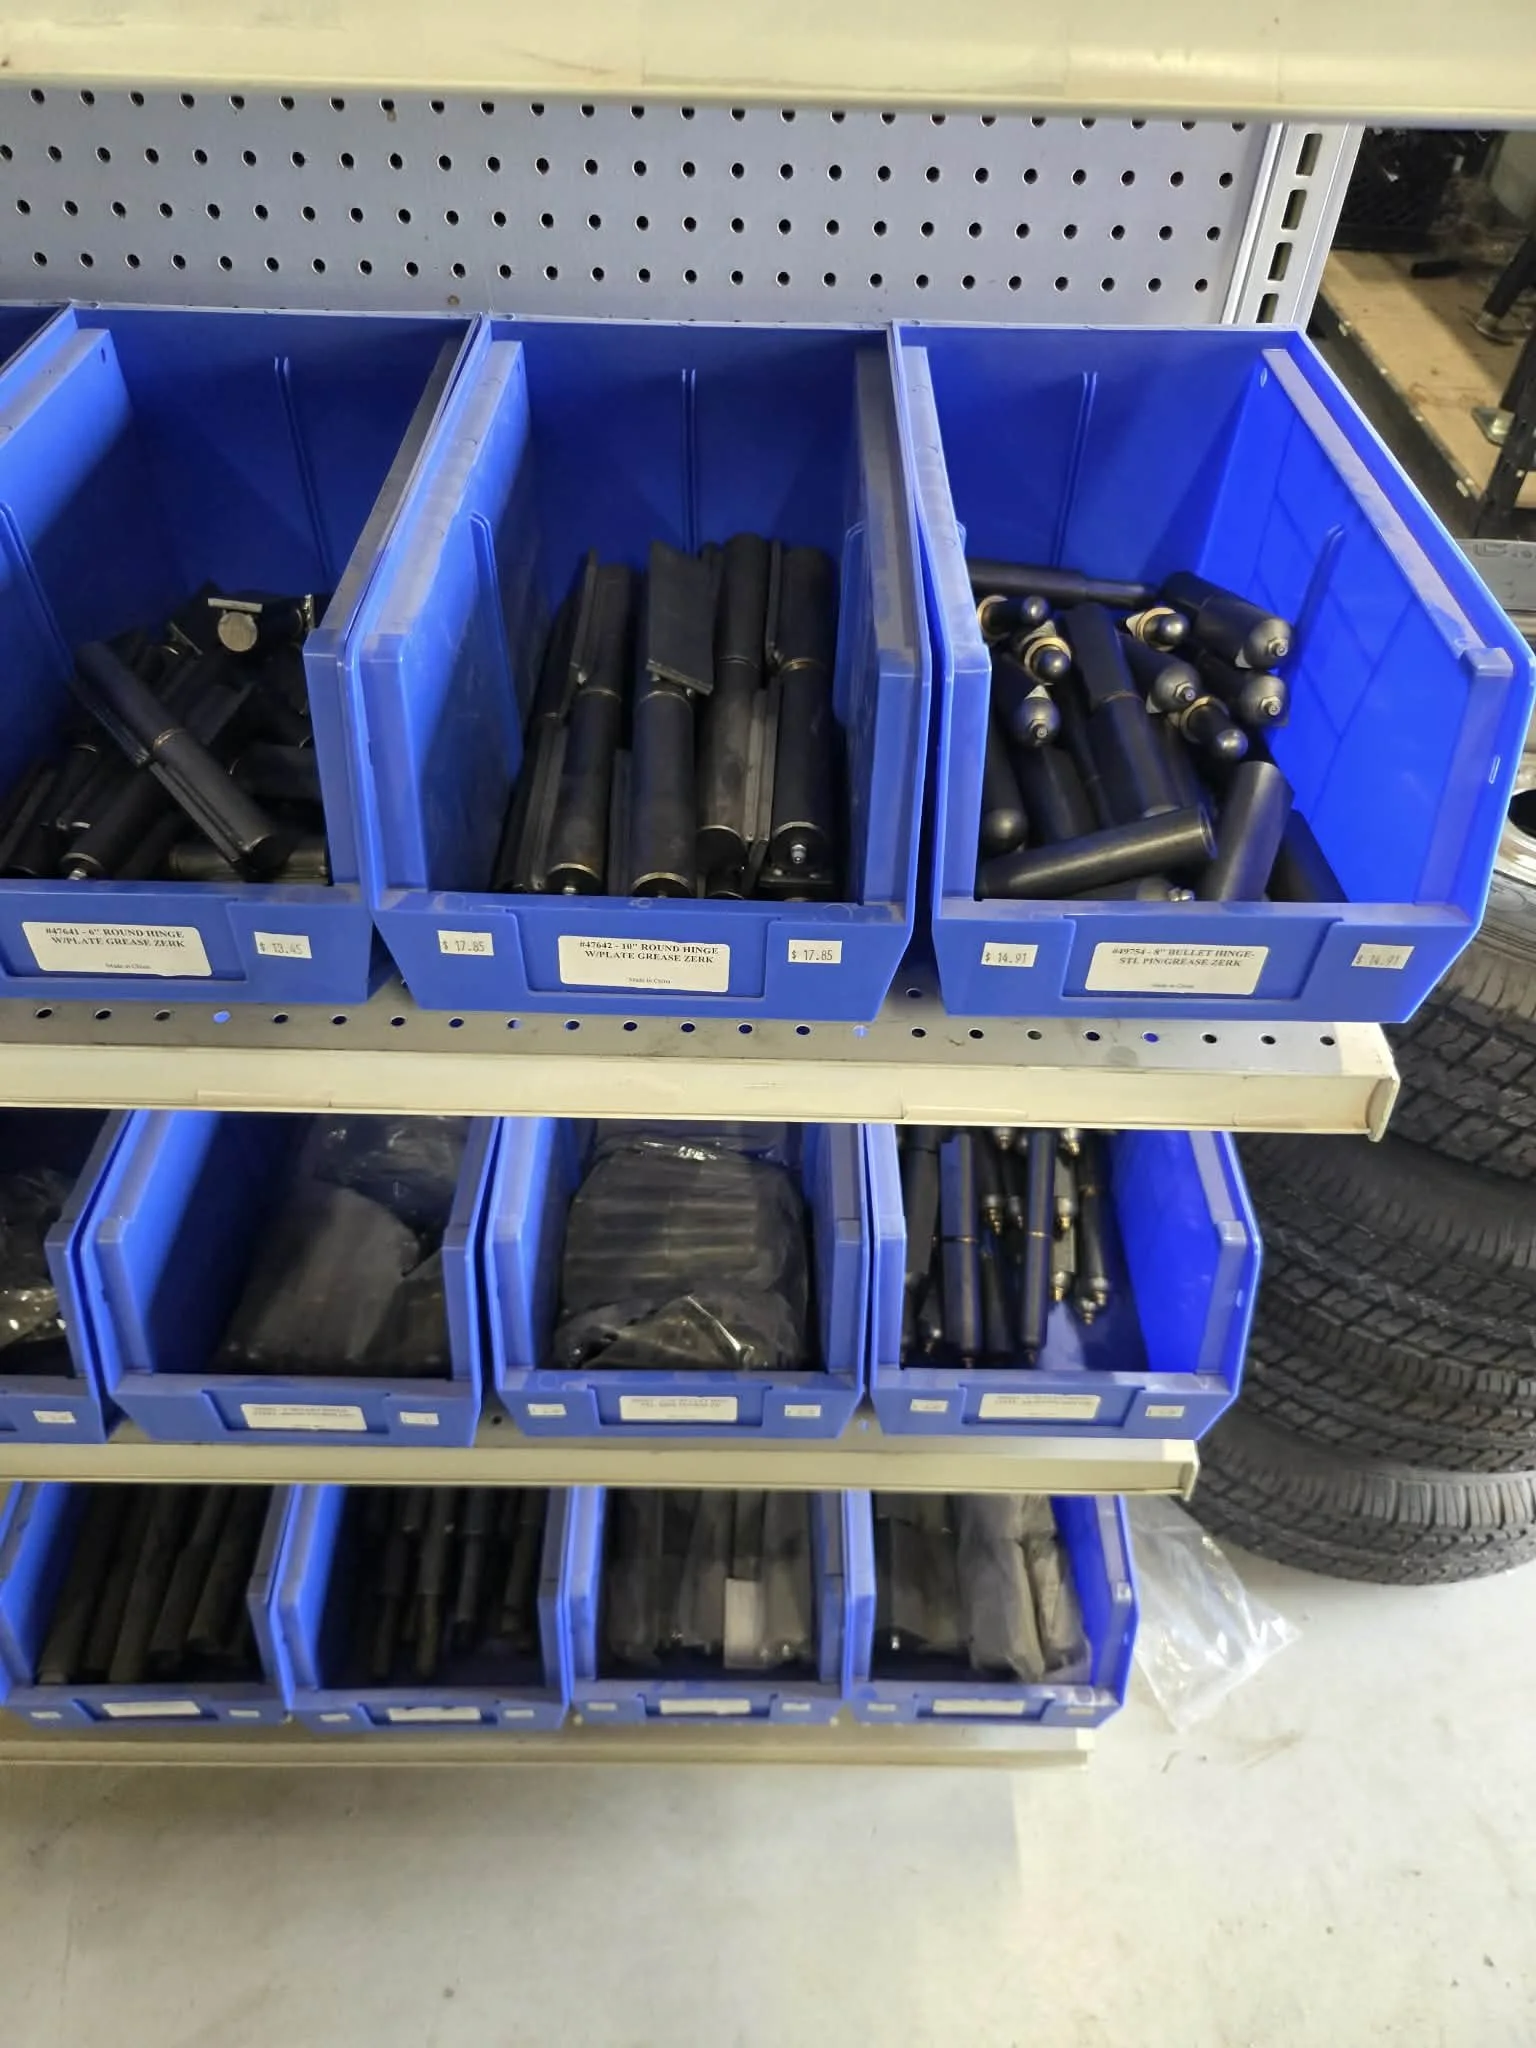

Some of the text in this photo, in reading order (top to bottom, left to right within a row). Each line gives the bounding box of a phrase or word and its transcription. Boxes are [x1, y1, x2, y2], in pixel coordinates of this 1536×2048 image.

[46, 928, 80, 936] #47641
[102, 929, 145, 937] ROUND
[146, 930, 185, 938] HINGE
[51, 936, 104, 945] W/PLATE
[105, 938, 152, 947] GREASE
[455, 940, 486, 952] 17.85
[579, 941, 613, 949] #47642
[622, 943, 639, 951] 10"
[641, 944, 681, 952] ROUND
[682, 946, 719, 955] HINGE
[1168, 949, 1214, 957] BULLET
[584, 950, 713, 963] W/PLATE GREASE ZERK
[791, 949, 833, 961] $ 17.85
[1119, 957, 1142, 965] STL
[1210, 959, 1242, 967] ZERK
